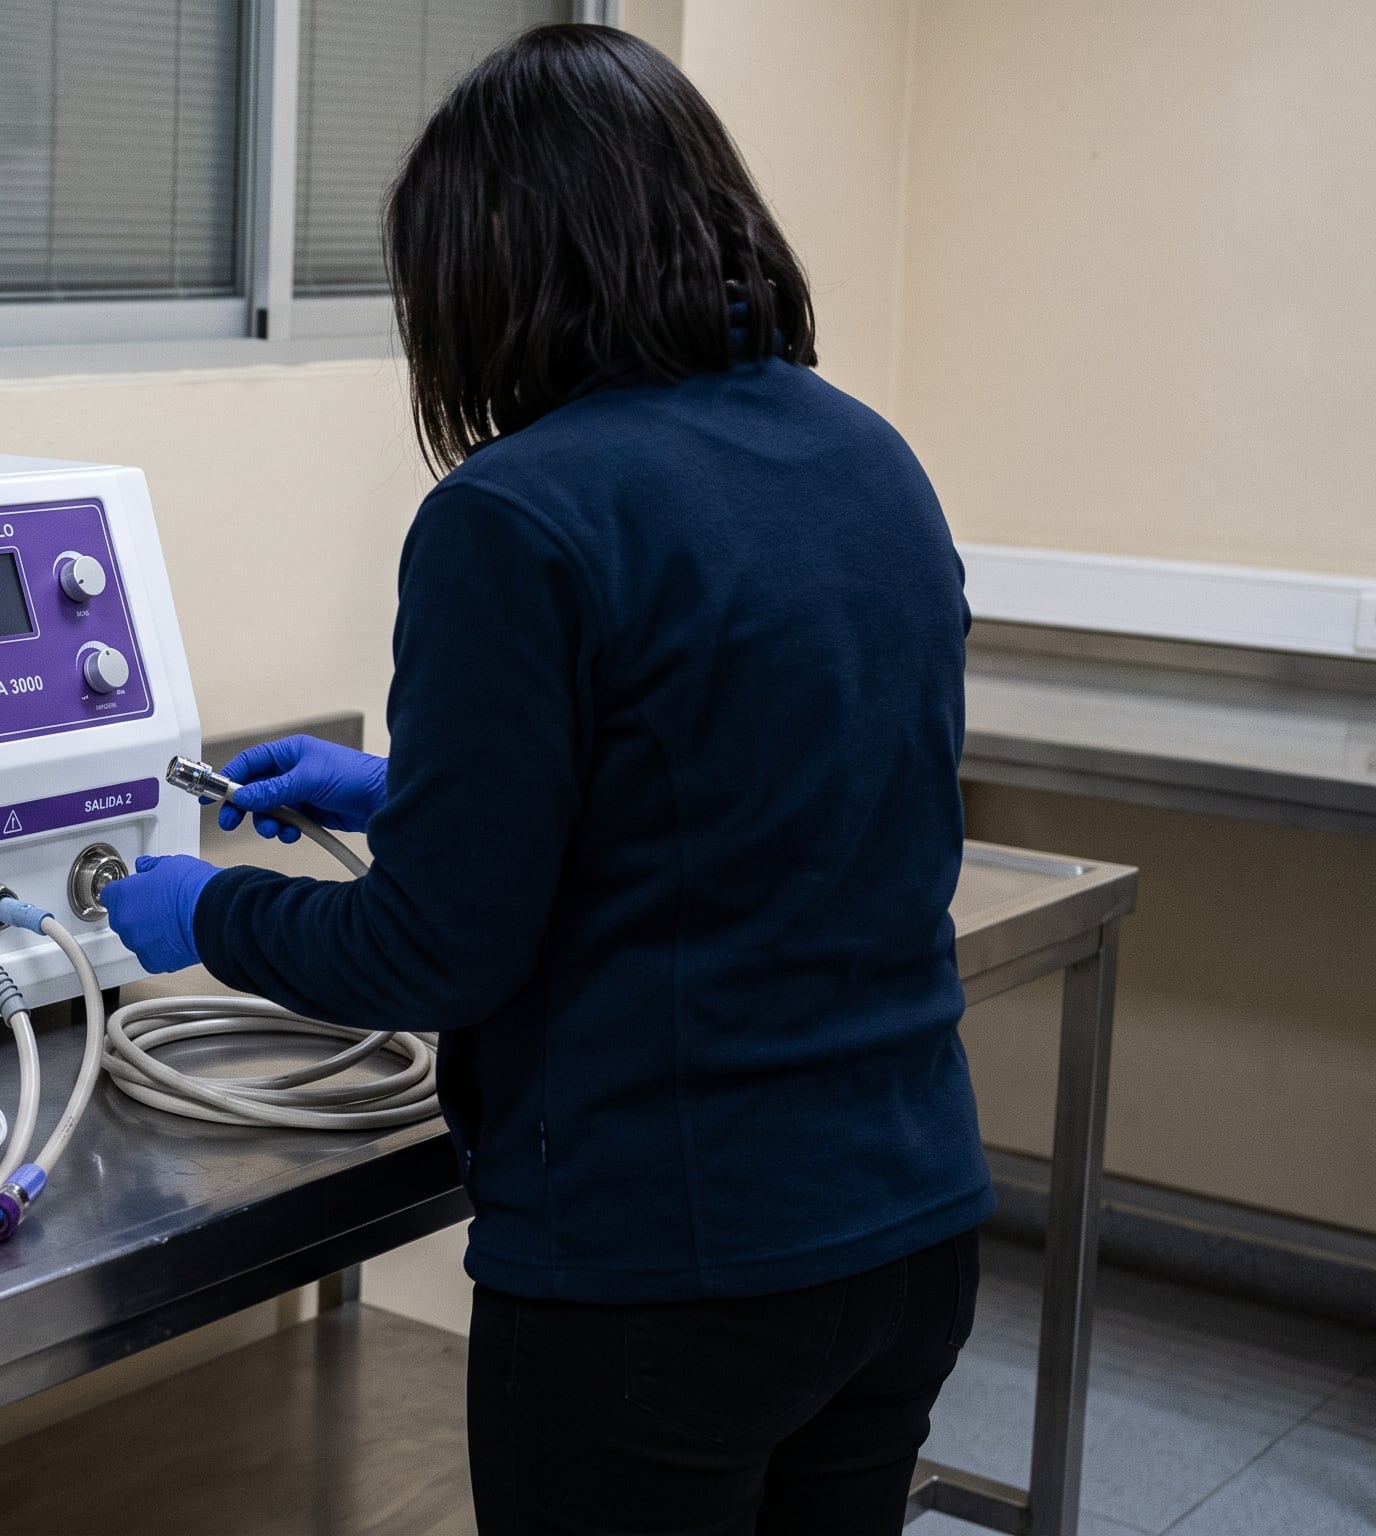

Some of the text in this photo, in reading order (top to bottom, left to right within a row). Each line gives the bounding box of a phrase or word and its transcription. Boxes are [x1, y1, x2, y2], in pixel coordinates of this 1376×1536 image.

[10, 675, 44, 694] 3000
[84, 793, 132, 813] SALIDA 2
